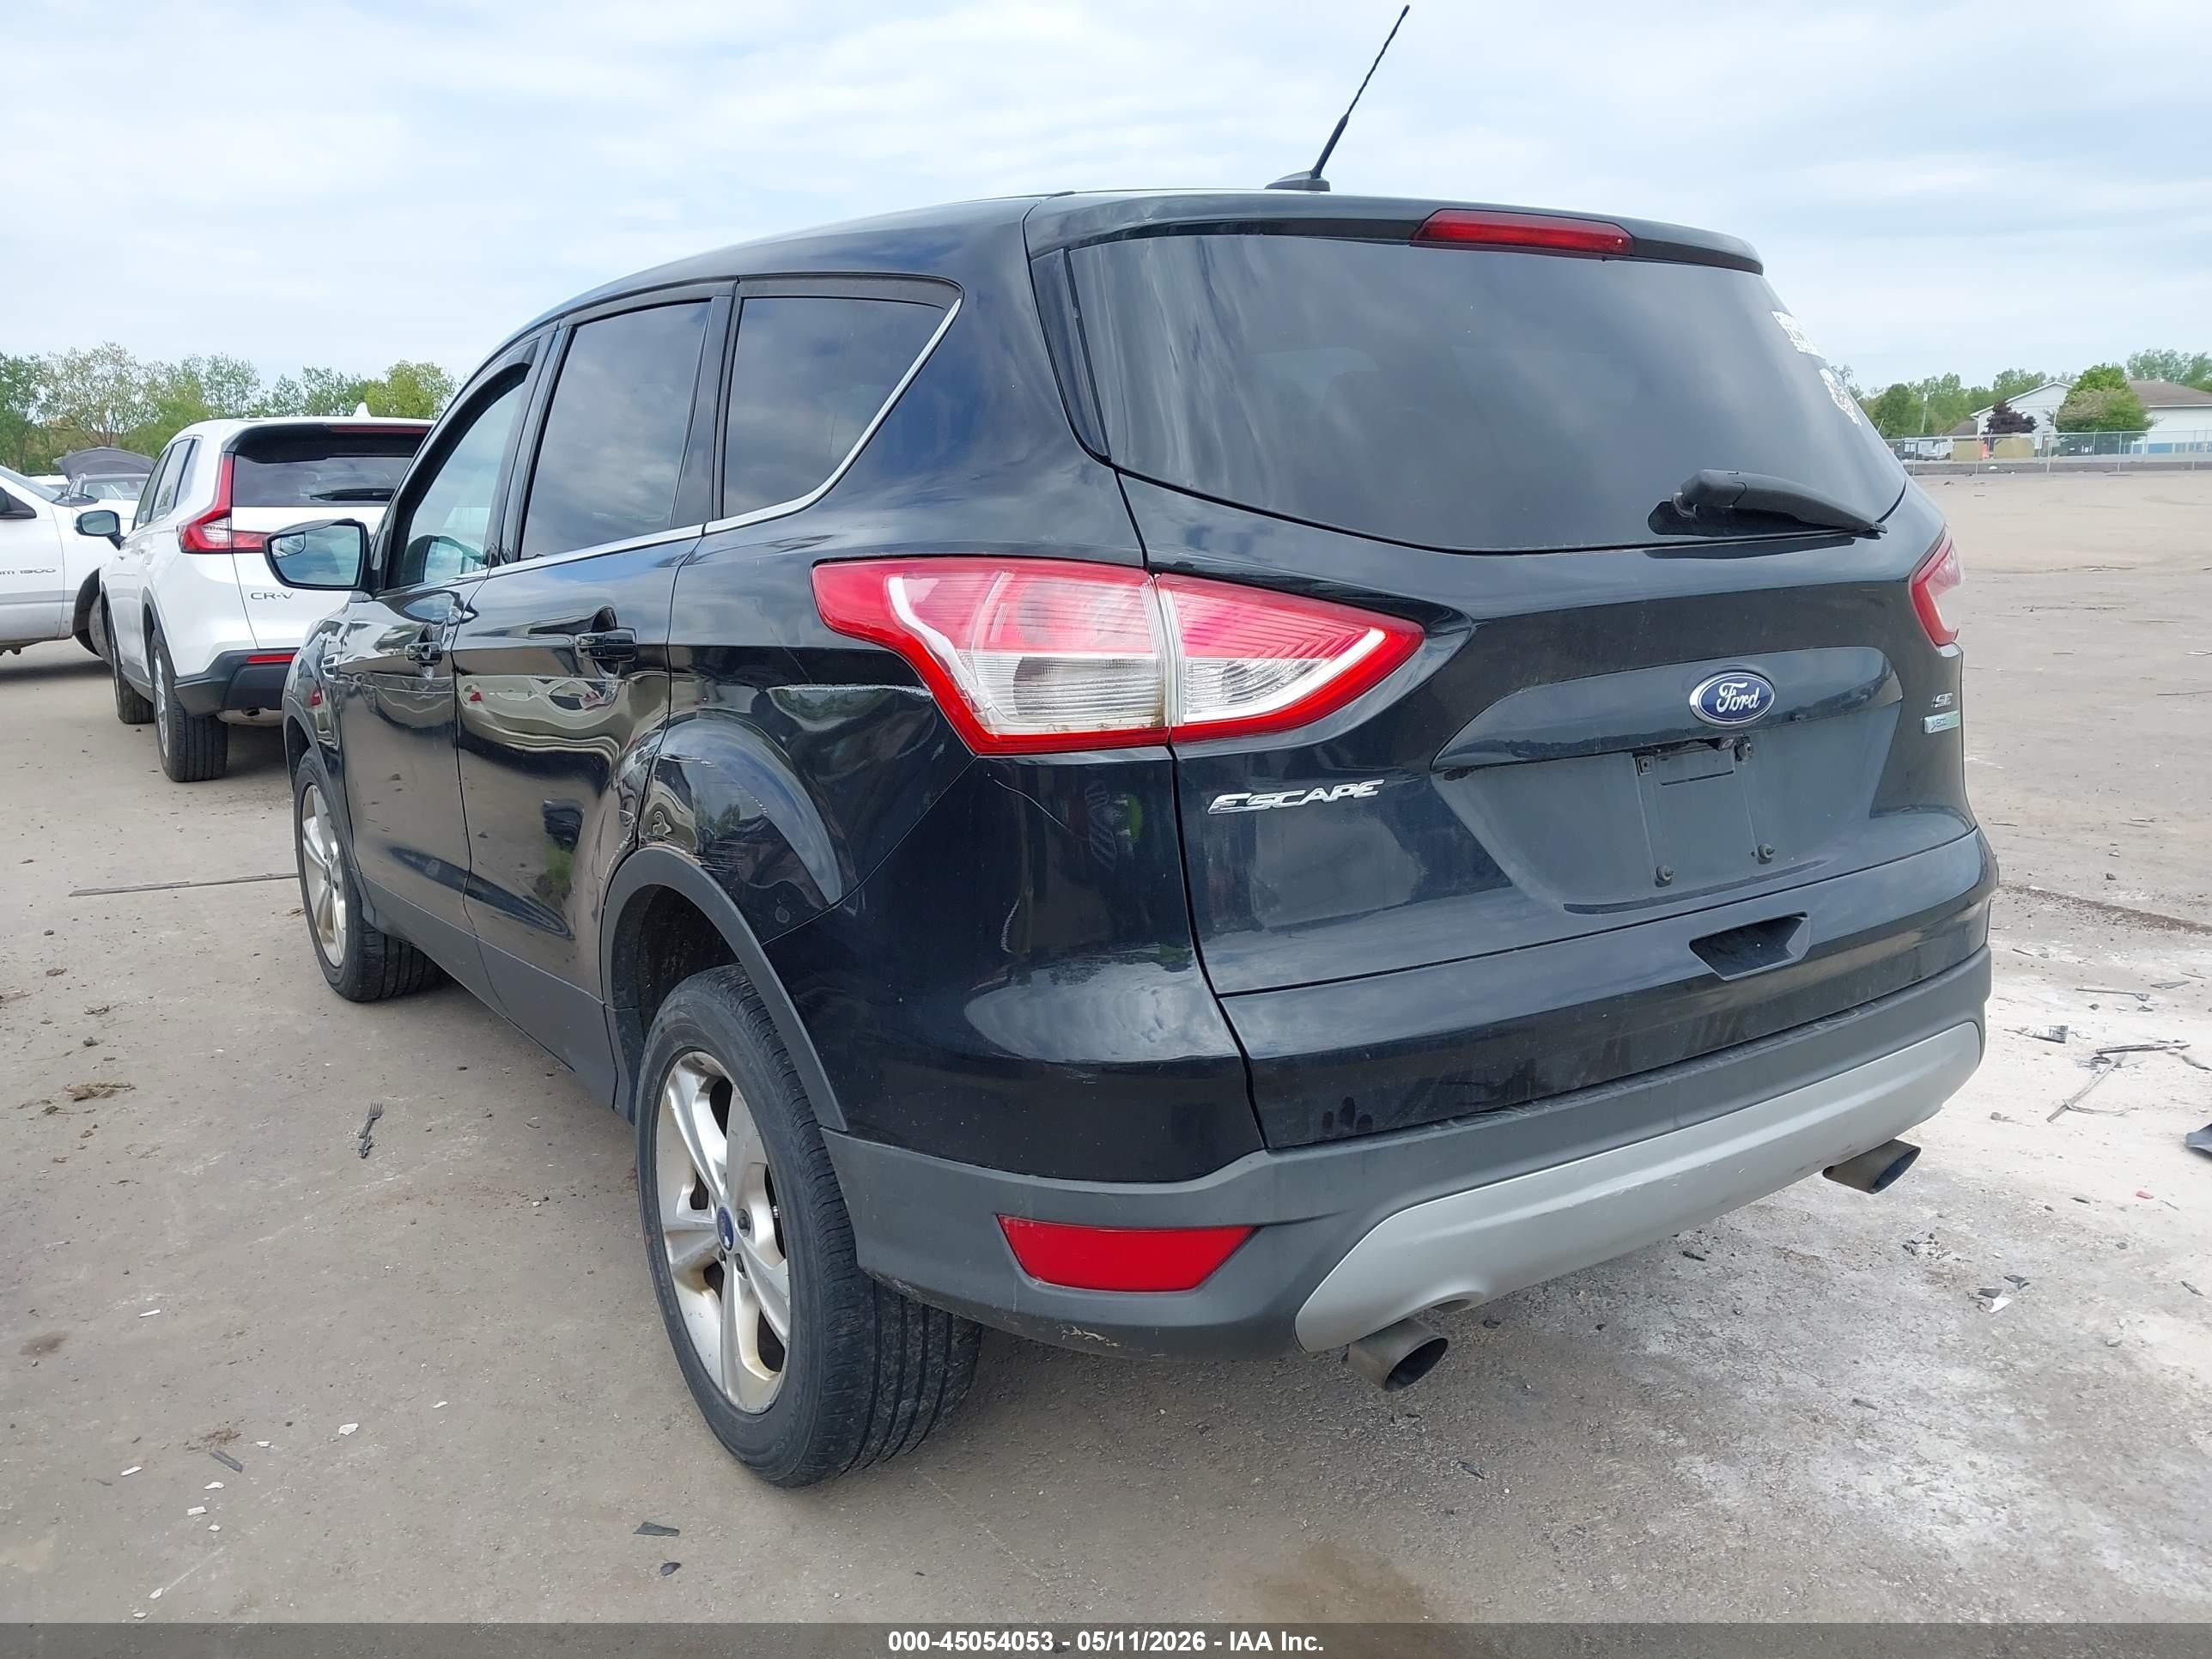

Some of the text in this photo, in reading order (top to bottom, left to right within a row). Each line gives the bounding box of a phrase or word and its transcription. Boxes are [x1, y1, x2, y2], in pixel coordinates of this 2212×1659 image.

[250, 592, 295, 600] CR-V
[1716, 682, 1760, 713] Ford
[1207, 779, 1385, 814] ESCAPE
